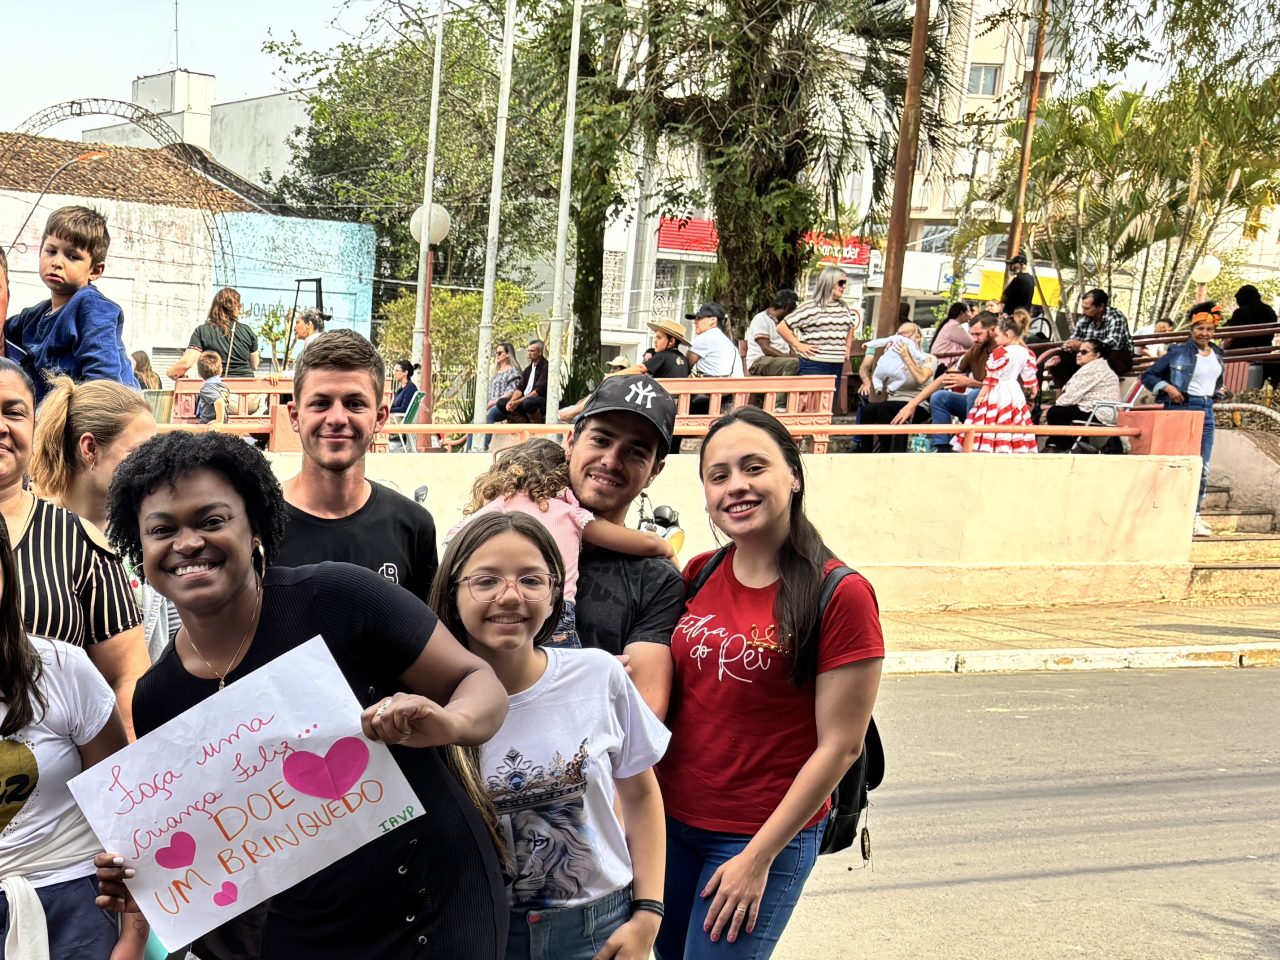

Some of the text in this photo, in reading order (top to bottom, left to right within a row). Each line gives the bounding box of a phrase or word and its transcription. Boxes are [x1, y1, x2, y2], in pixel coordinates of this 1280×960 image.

[718, 633, 771, 683] Rei
[196, 714, 276, 766] uma
[212, 781, 296, 842] DOE
[377, 805, 416, 834] IAVP
[153, 779, 384, 915] UM BRINQUEDO
